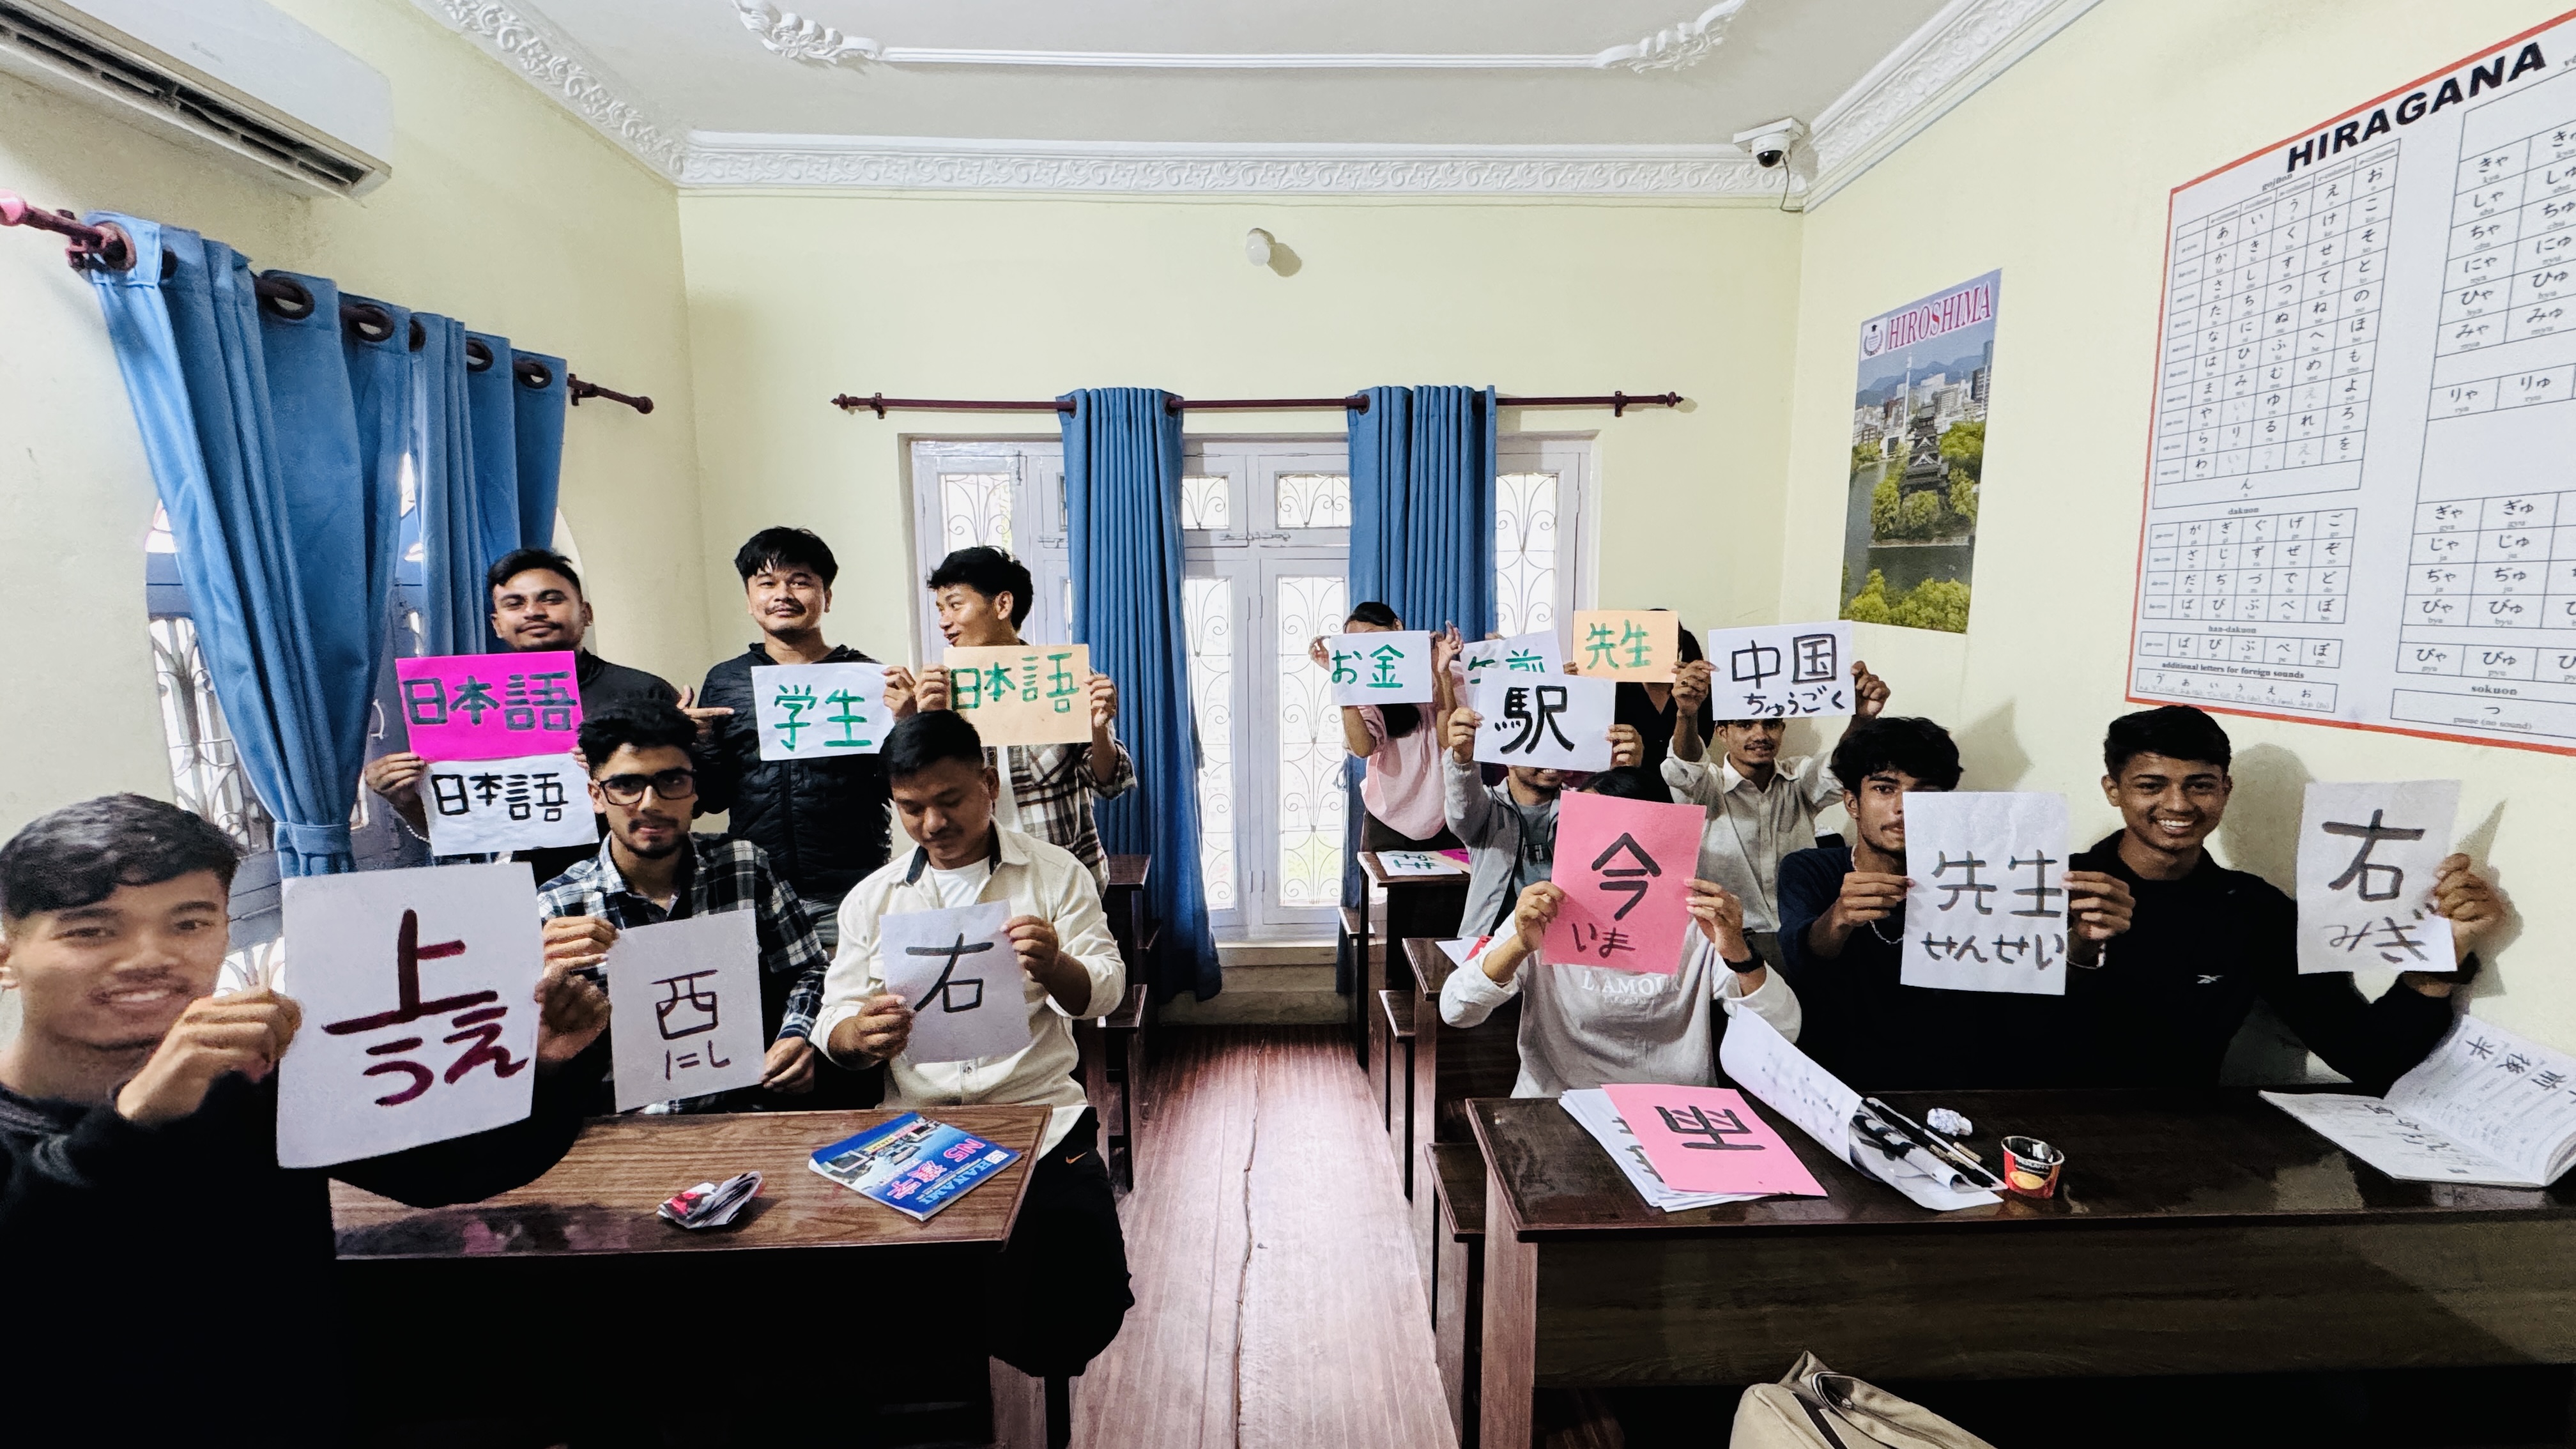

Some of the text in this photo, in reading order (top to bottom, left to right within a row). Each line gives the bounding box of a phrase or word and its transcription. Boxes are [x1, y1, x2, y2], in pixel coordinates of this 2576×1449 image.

[2287, 42, 2547, 172] HIRAGANA
[2479, 157, 2508, 172] きゃ
[2474, 192, 2504, 208] しゃ
[2464, 236, 2572, 273] にゃ にゅ
[2471, 225, 2500, 240] ちゃ
[2461, 272, 2568, 305] ひゃ ひゅ
[1888, 283, 1991, 350] HIROSHIMA
[2456, 308, 2563, 339] みゃ みゅ
[2451, 376, 2550, 402] りゃ りゅ
[2435, 500, 2533, 519] ぎゃ ぎゅ
[2431, 535, 2529, 551] じゃ じゅ
[1586, 619, 1653, 670] 先生
[2209, 625, 2257, 634] han-dakuon
[951, 652, 1080, 714] 日本語
[1331, 643, 1405, 689] お金
[1731, 633, 1837, 689] 中国
[2162, 662, 2198, 670] additional
[2200, 664, 2224, 673] letters
[2241, 668, 2270, 677] foreign
[2274, 670, 2304, 678] sounds
[403, 671, 578, 732] 日本語
[1742, 685, 1845, 717] ちゅうごく
[2471, 684, 2517, 695] sokuon
[774, 684, 873, 752] 学生
[1494, 685, 1575, 755] 駅
[431, 771, 569, 822] 日本語
[1591, 832, 1661, 921] 今
[2321, 808, 2426, 902] 右
[1931, 848, 2064, 918] 先生
[1572, 922, 1636, 959] いま
[1920, 930, 2066, 971] せんせい
[2323, 901, 2439, 965] みぎ
[321, 908, 498, 1036] 上
[905, 932, 995, 1013] 右
[650, 969, 719, 1041] 西
[362, 1006, 530, 1107] うえ
[664, 1039, 732, 1081] にし
[943, 1137, 987, 1163] N5
[1652, 1105, 1767, 1151] 雨
[924, 1158, 992, 1206] HANAMI
